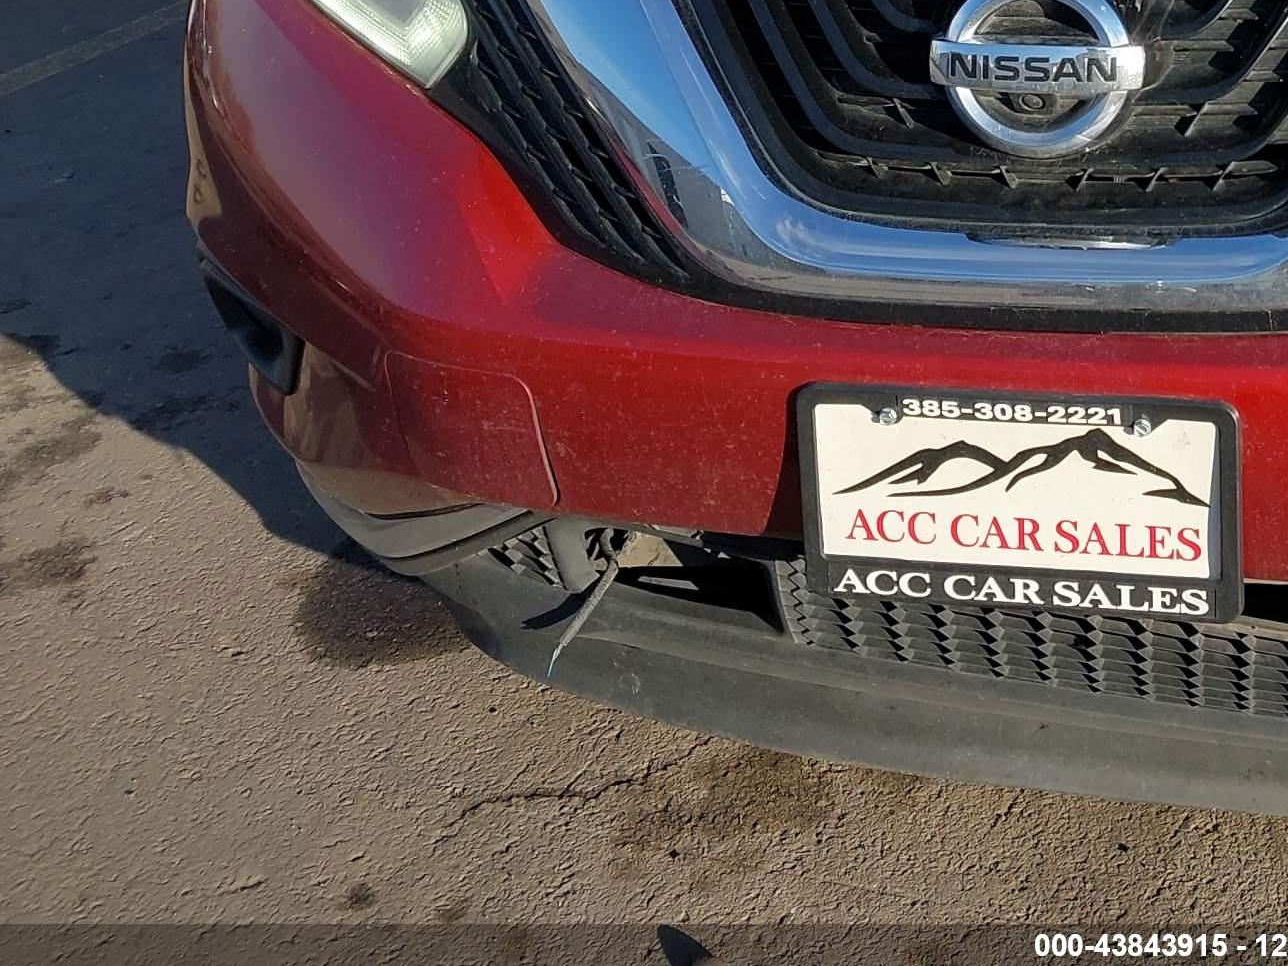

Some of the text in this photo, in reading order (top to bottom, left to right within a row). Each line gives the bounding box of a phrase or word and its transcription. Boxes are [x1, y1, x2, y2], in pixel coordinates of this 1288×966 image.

[949, 53, 1117, 82] NISSAN
[902, 398, 1123, 426] 385-308-2221
[845, 508, 1203, 561] ACC CAR SALES
[834, 569, 1209, 615] ACC CAR SALES
